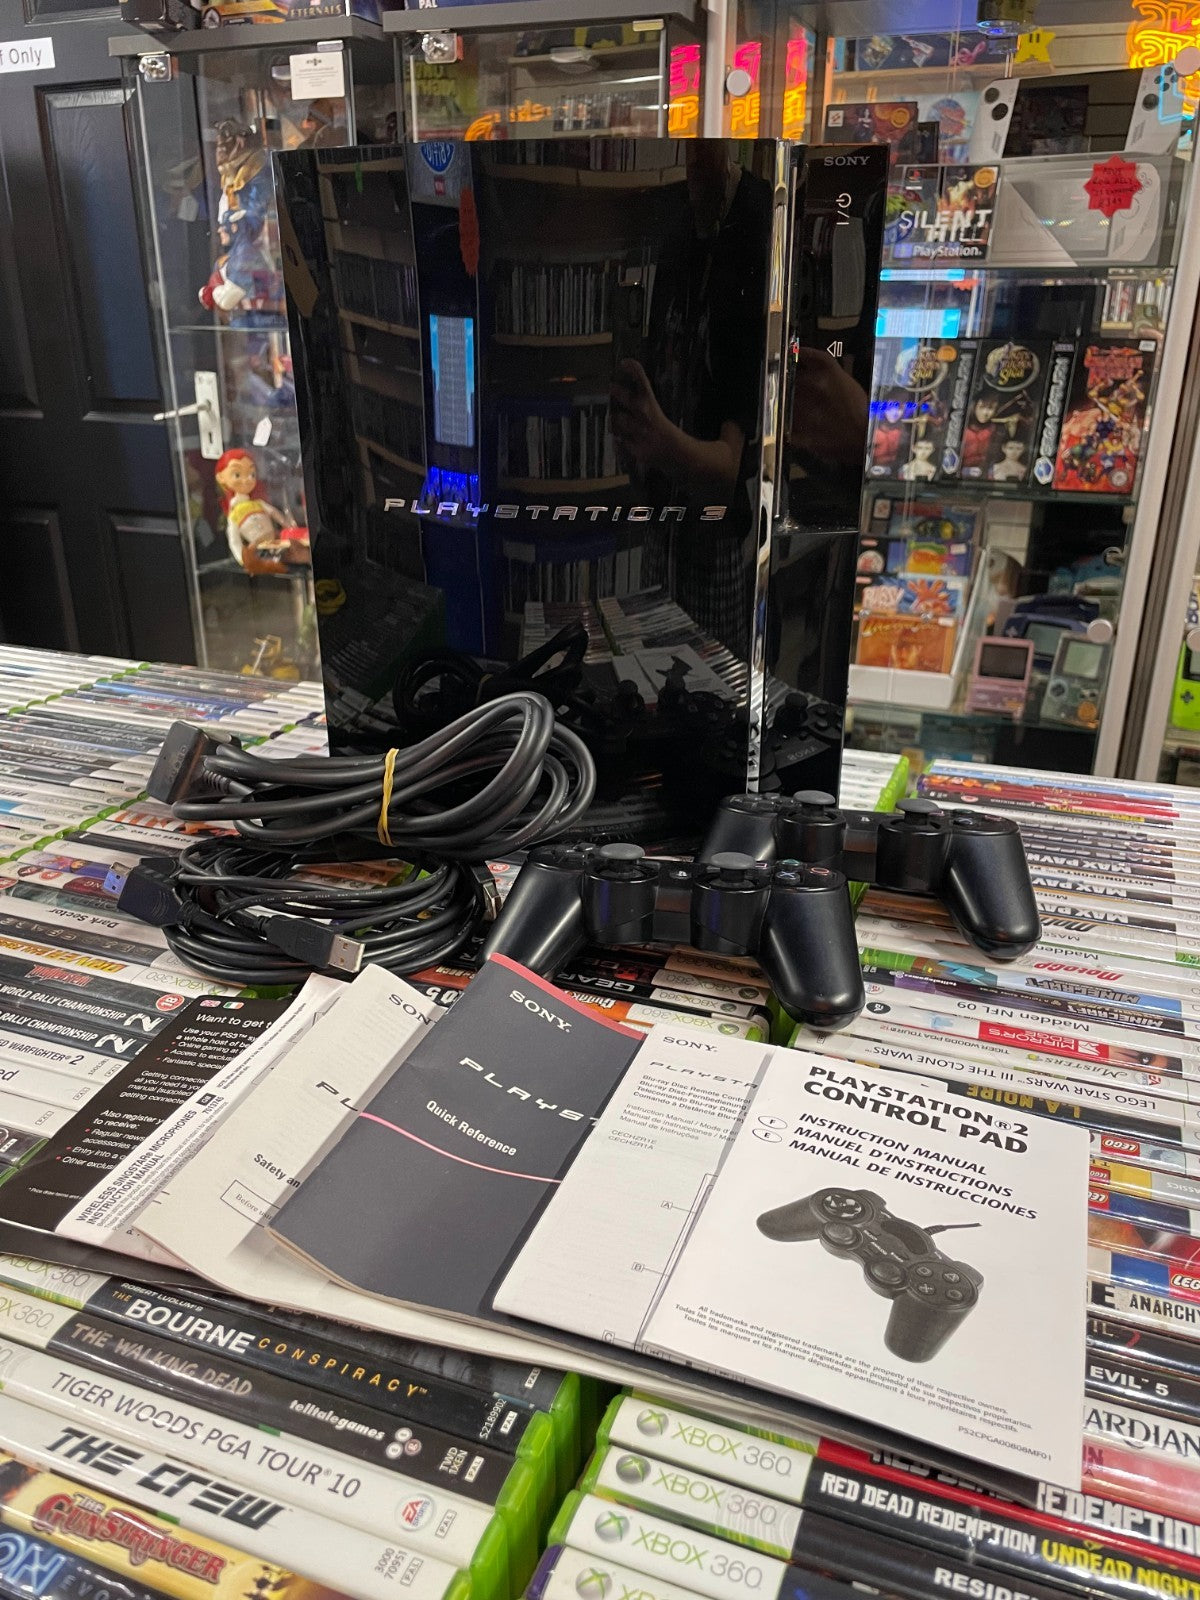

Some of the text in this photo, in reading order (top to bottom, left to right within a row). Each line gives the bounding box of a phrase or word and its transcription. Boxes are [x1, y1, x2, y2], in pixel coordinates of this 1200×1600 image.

[9, 47, 42, 67] Only
[824, 156, 870, 167] SONY
[899, 209, 993, 228] SILENT
[384, 498, 727, 521] PLAYSTATION 3
[1082, 860, 1132, 875] MAX
[1075, 882, 1127, 898] MAX
[49, 907, 120, 929] Dark Sector
[666, 974, 735, 993] XBOX 360
[1034, 961, 1123, 981] MotoGP
[1, 984, 127, 1020] WORLD RALLY CHAMPIONSHIP
[659, 992, 719, 1008] XBOX 360
[1025, 976, 1141, 1004] MINECRAFT
[196, 1013, 264, 1029] Want to get
[388, 993, 438, 1026] SON
[642, 1007, 715, 1029] XBOX 360
[957, 1001, 1090, 1032] Madden NFL 09
[1066, 1004, 1164, 1028] MINECRAFT
[3, 1012, 99, 1041] RALLY CHAMPIONSHIP
[988, 1028, 1075, 1050] MIRROR'S
[69, 1055, 84, 1066] 2
[917, 1056, 965, 1071] CLONE
[968, 1068, 997, 1078] THE
[642, 1074, 751, 1104] Blu-ray Disc Remote Control
[1000, 1071, 1014, 1081] III
[639, 1080, 747, 1111] Blu-ray Disc-Fernbedienung
[967, 1083, 1035, 1109] NOIRE
[1074, 1086, 1111, 1101] STAR
[1115, 1095, 1156, 1110] LEGO
[100, 1109, 158, 1125] Also register
[426, 1100, 517, 1156] Quick Reference
[619, 1115, 647, 1127] Manual
[626, 1103, 722, 1133] Instruction Manual Mode
[803, 1081, 1028, 1154] CONTROL PAD
[82, 1137, 132, 1150] accessories
[799, 1113, 909, 1151] INSTRUCTION
[912, 1147, 988, 1176] MANUAL
[1102, 1139, 1137, 1152] LEGO
[75, 1186, 117, 1221] WIRELESS
[149, 1109, 198, 1154] MICROPHONES
[254, 1153, 286, 1182] Safety
[793, 1126, 863, 1154] MANUEL
[868, 1149, 1013, 1198] D'INSTRUCTIONS
[86, 1153, 165, 1225] INSTRUCTION MANUAL
[788, 1140, 1038, 1220] MANUAL DE INSTRUCCIONES
[50, 1264, 91, 1288] 360
[111, 1290, 131, 1302] THE
[120, 1282, 204, 1312] ROBERT LUDLUM'S
[125, 1297, 255, 1354] BOURNE
[70, 1322, 253, 1397] THE WALKING DEAD
[709, 1308, 748, 1327] trademarks
[749, 1322, 763, 1332] and
[765, 1328, 801, 1345] registered
[802, 1341, 843, 1359] trademarks
[844, 1355, 857, 1364] are
[858, 1359, 871, 1369] the
[872, 1364, 905, 1382] property
[906, 1376, 915, 1384] of
[916, 1379, 934, 1391] their
[936, 1386, 975, 1404] respective
[977, 1400, 1009, 1414] owners.
[1155, 1382, 1169, 1397] 5
[289, 1399, 386, 1441] telltalegames
[51, 1371, 114, 1406] TIGER
[113, 1393, 204, 1440] WOODS
[202, 1427, 253, 1459] PGA
[327, 1473, 362, 1499] 10
[438, 1446, 459, 1473] TWD
[671, 1421, 793, 1477] XBOX 360
[45, 1426, 286, 1530] THE CREW
[75, 1493, 105, 1514] THE
[652, 1468, 778, 1526] XBOX 360
[402, 1499, 424, 1523] EA
[412, 1500, 431, 1527] SPORTS
[33, 1493, 227, 1585] GUNSTRINGER
[820, 1471, 860, 1503] RED
[863, 1484, 914, 1519] DEAD
[917, 1502, 1037, 1556] REDEMPTION
[1041, 1538, 1134, 1582] UNDEAD
[374, 1547, 395, 1573] 3000
[632, 1525, 763, 1590] XBOX 360
